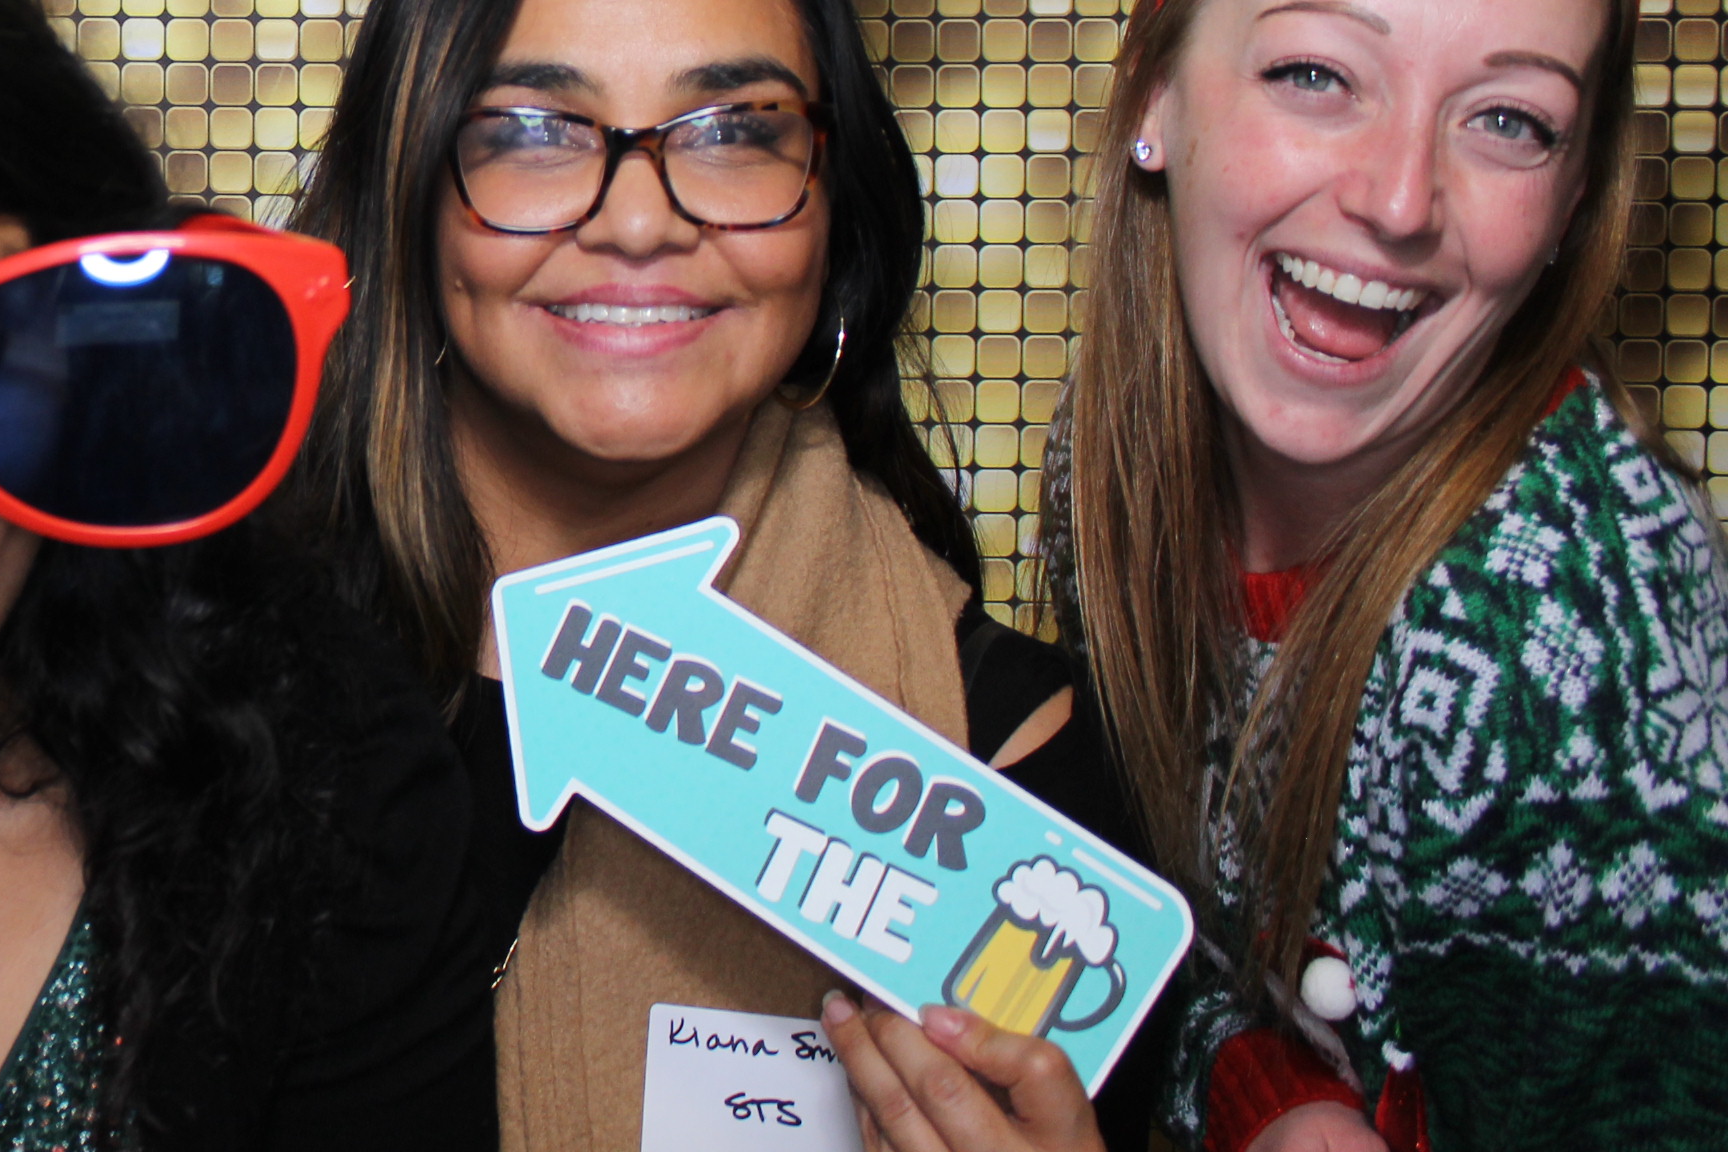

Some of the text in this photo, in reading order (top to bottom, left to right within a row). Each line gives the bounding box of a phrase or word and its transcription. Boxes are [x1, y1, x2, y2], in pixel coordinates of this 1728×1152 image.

[540, 599, 986, 872] HERE FOR
[754, 807, 939, 964] THE
